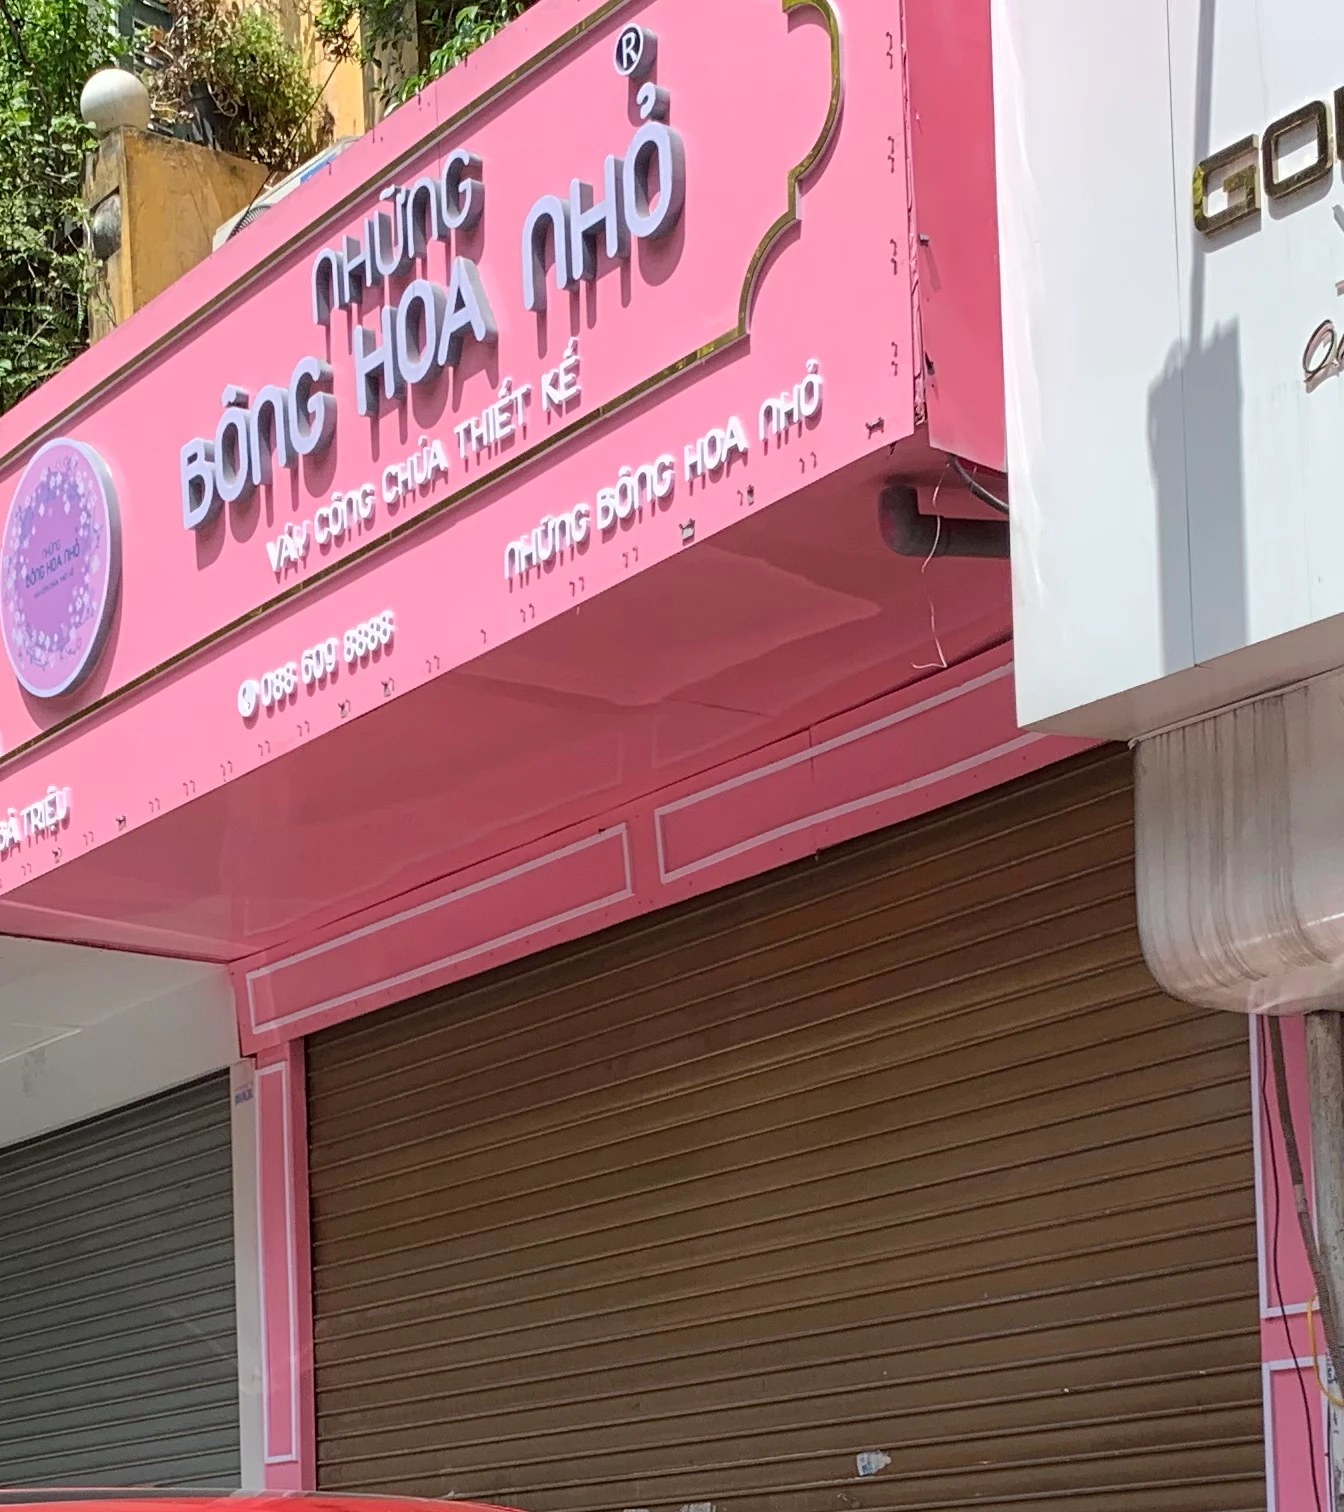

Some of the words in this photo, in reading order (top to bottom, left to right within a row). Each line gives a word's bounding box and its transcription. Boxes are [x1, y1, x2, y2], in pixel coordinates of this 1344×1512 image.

[180, 356, 335, 531] BÔNG
[355, 256, 496, 416] HOA
[522, 82, 684, 312] NHỎ
[311, 149, 484, 326] NHỮNG
[266, 521, 311, 573] VÁY
[314, 483, 376, 546] CÔNG
[382, 435, 450, 504] CHÚA
[454, 377, 532, 459] THIẾT
[541, 336, 583, 411] KẾ
[504, 503, 592, 580] NHỮNG
[596, 454, 676, 531] BÔNG
[684, 415, 749, 482] HOA
[758, 358, 824, 442] NHỎ
[261, 662, 298, 706] 088
[301, 638, 340, 684] 609
[343, 610, 396, 663] 8888
